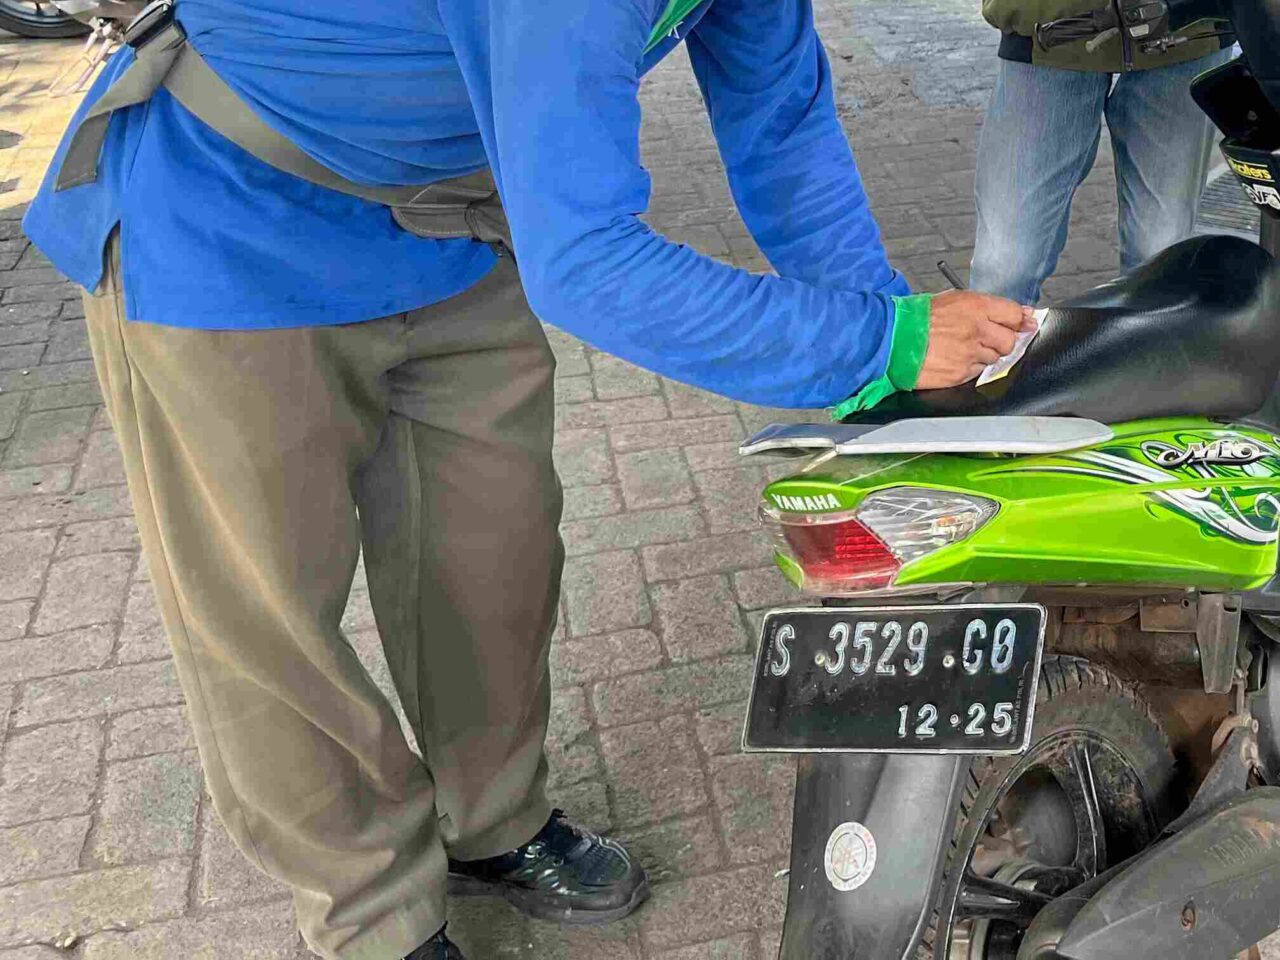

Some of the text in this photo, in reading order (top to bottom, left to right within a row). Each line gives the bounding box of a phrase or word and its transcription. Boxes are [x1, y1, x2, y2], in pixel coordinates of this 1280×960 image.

[771, 493, 842, 511] YAMAHA
[770, 624, 796, 677] S
[825, 620, 929, 677] 3529
